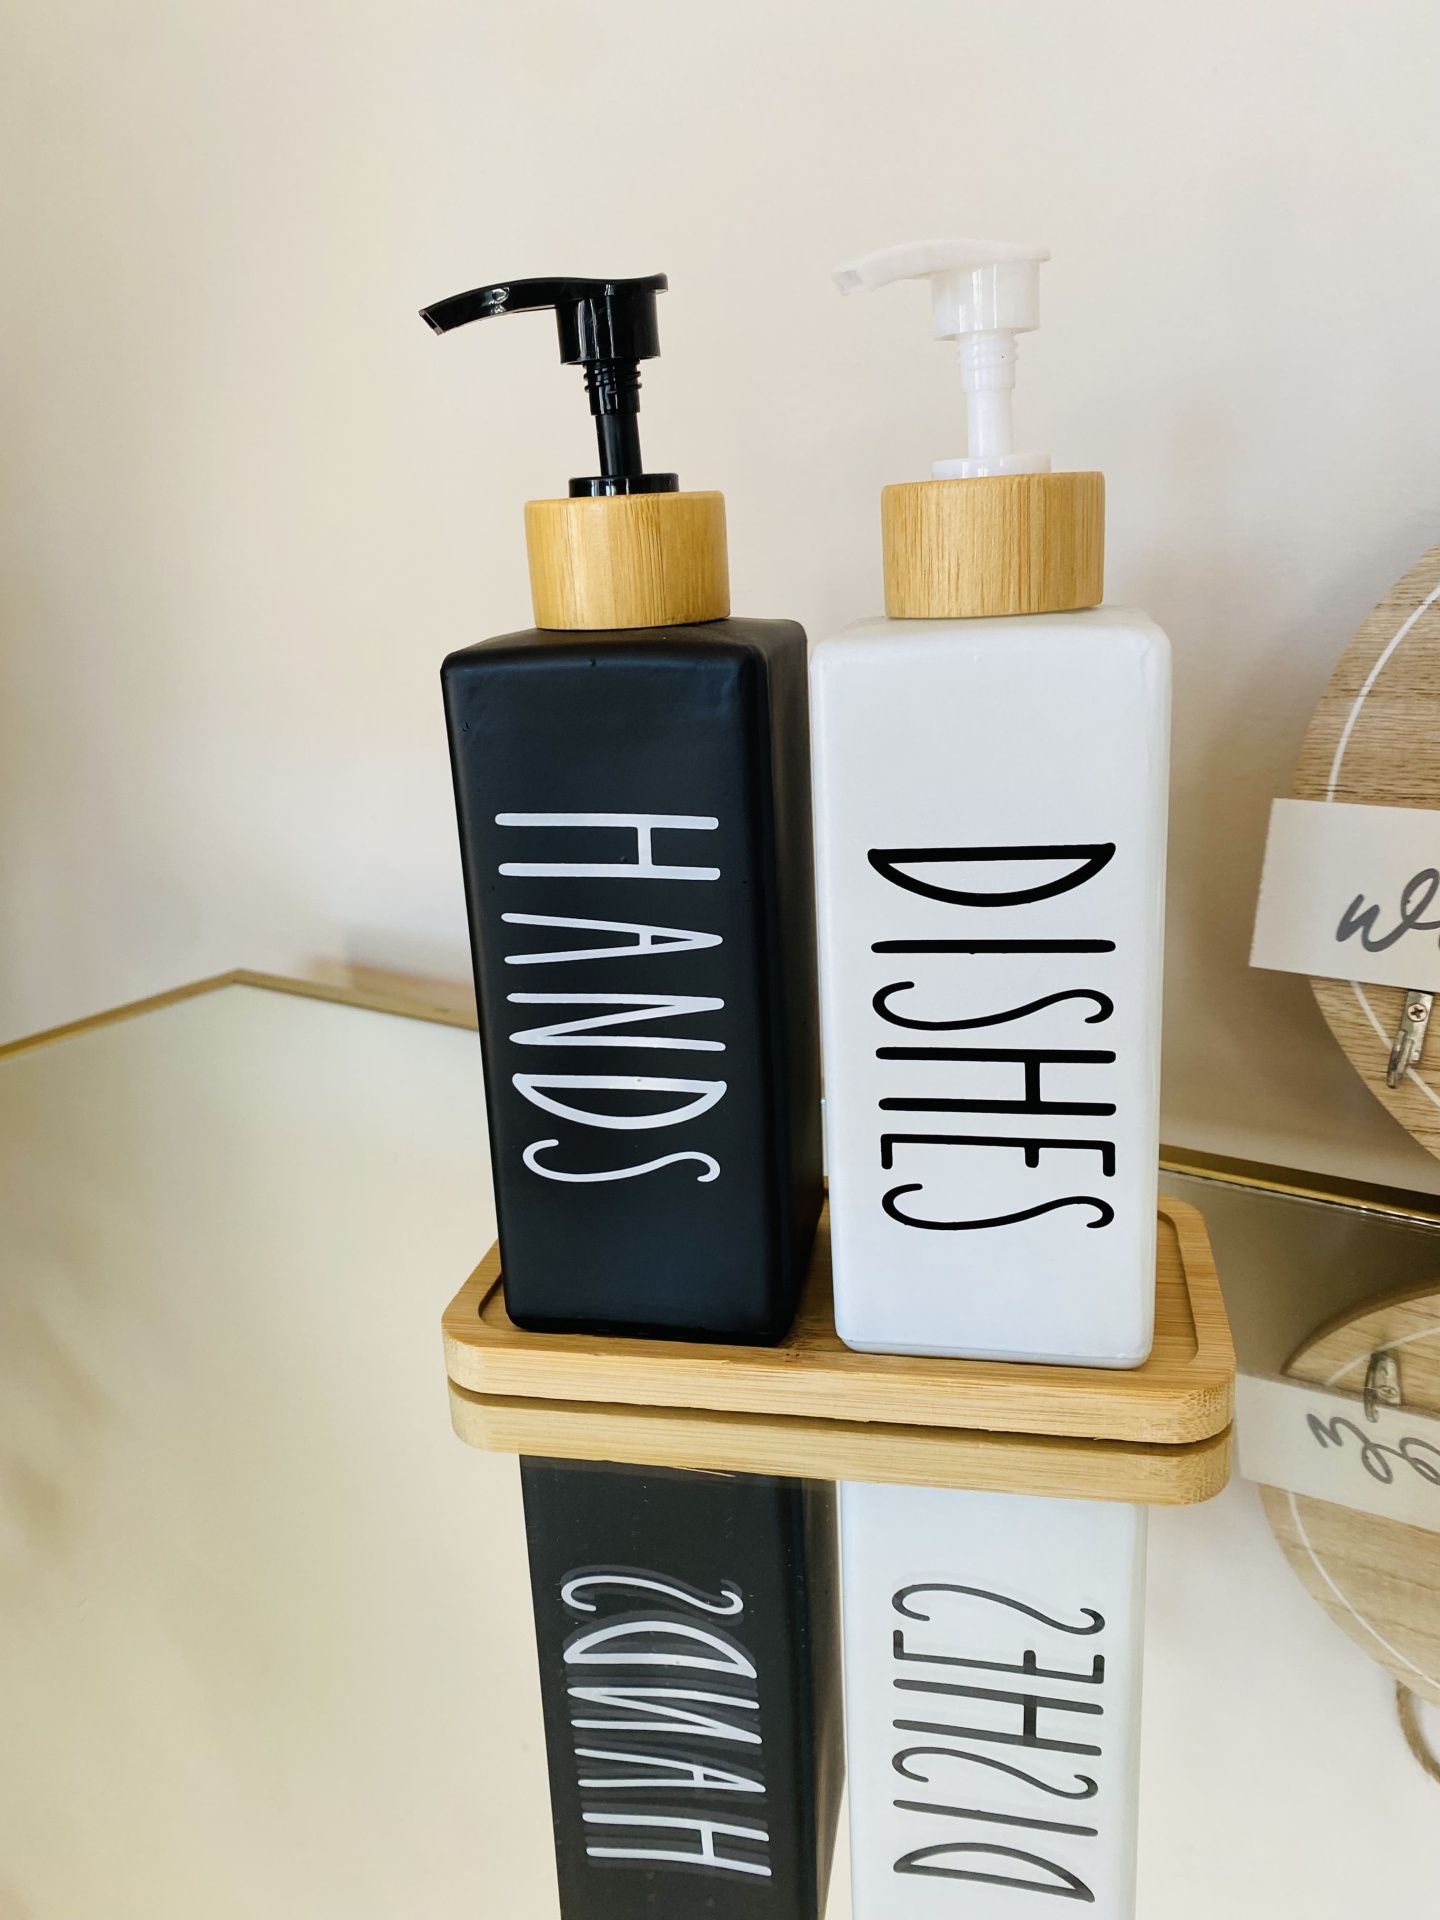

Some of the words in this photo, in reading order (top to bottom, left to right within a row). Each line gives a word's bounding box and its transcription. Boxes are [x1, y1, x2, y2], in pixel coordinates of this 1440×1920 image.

[494, 813, 727, 1183] HANDS
[867, 842, 1116, 1231] DISHES
[1335, 867, 1440, 953] we
